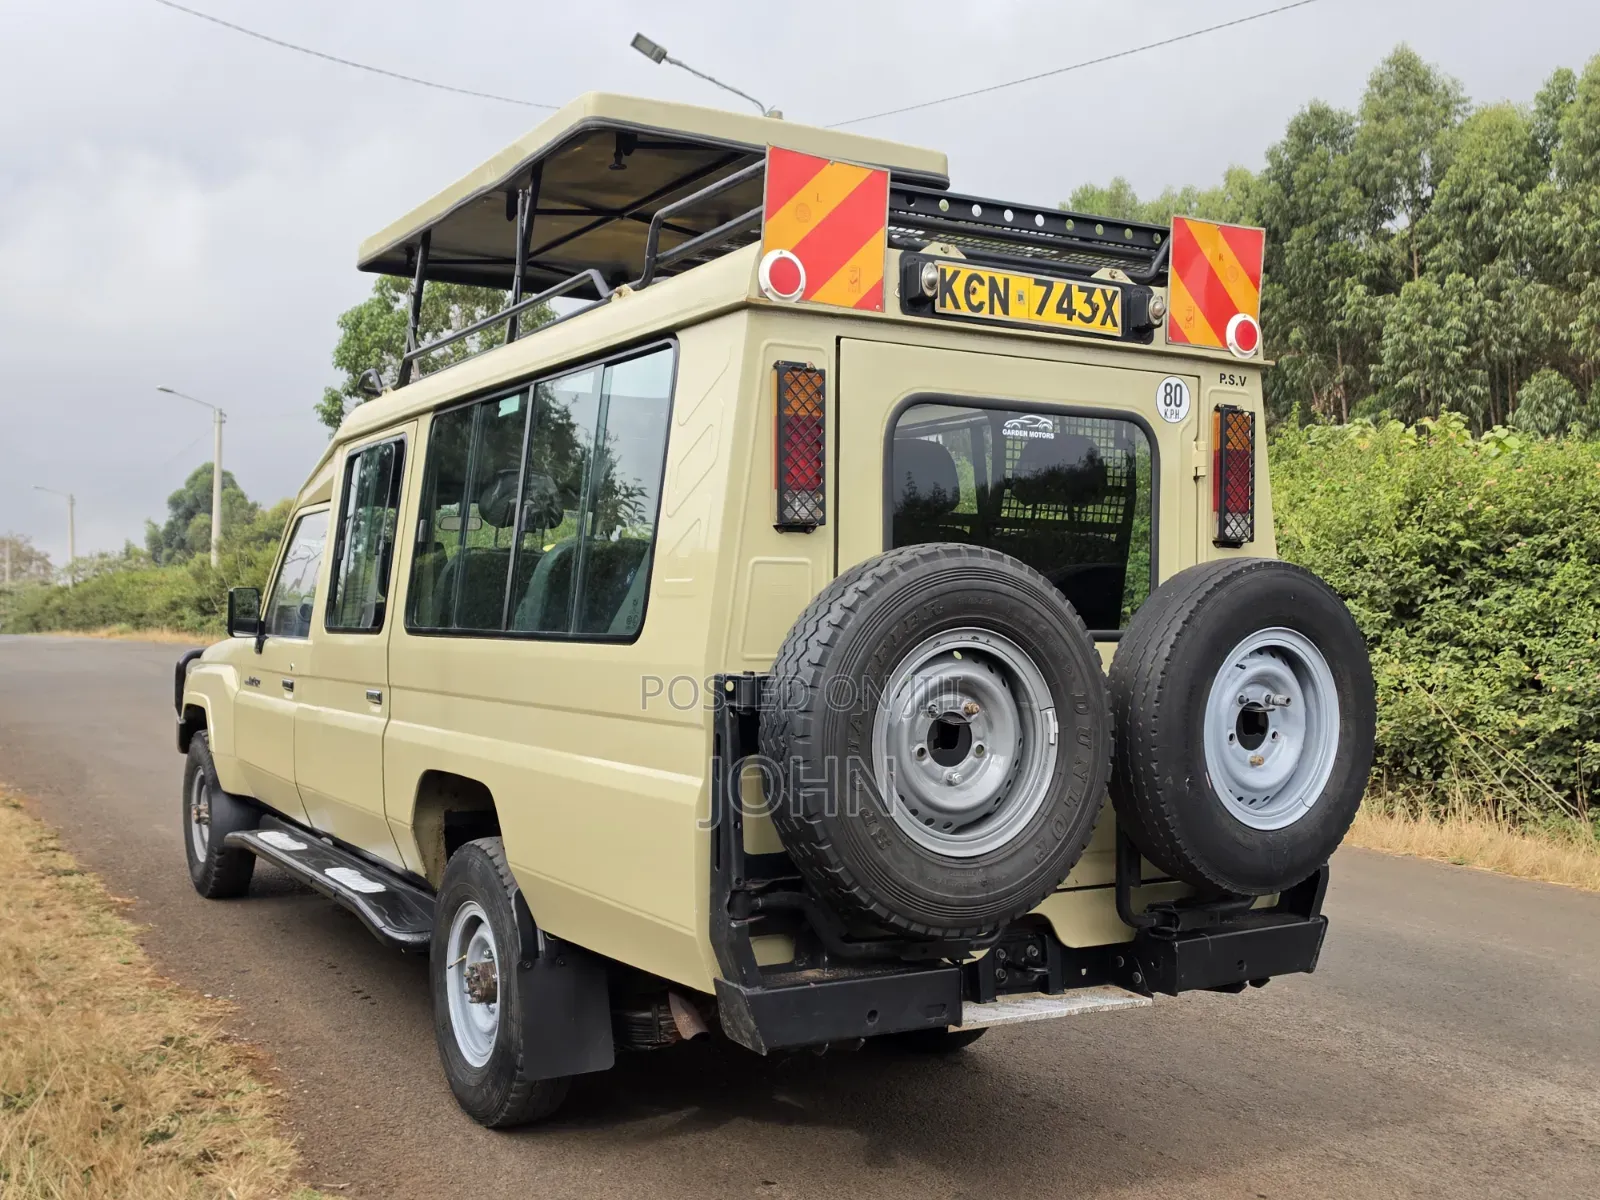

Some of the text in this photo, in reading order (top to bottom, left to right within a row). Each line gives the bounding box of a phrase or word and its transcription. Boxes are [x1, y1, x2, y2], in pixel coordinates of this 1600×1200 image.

[939, 267, 1119, 328] KCN 743X
[1219, 373, 1247, 387] P.S.V
[1164, 382, 1183, 408] 80
[1002, 428, 1055, 440] GARDEN MOTORS
[1033, 691, 1093, 865] DUNLOP
